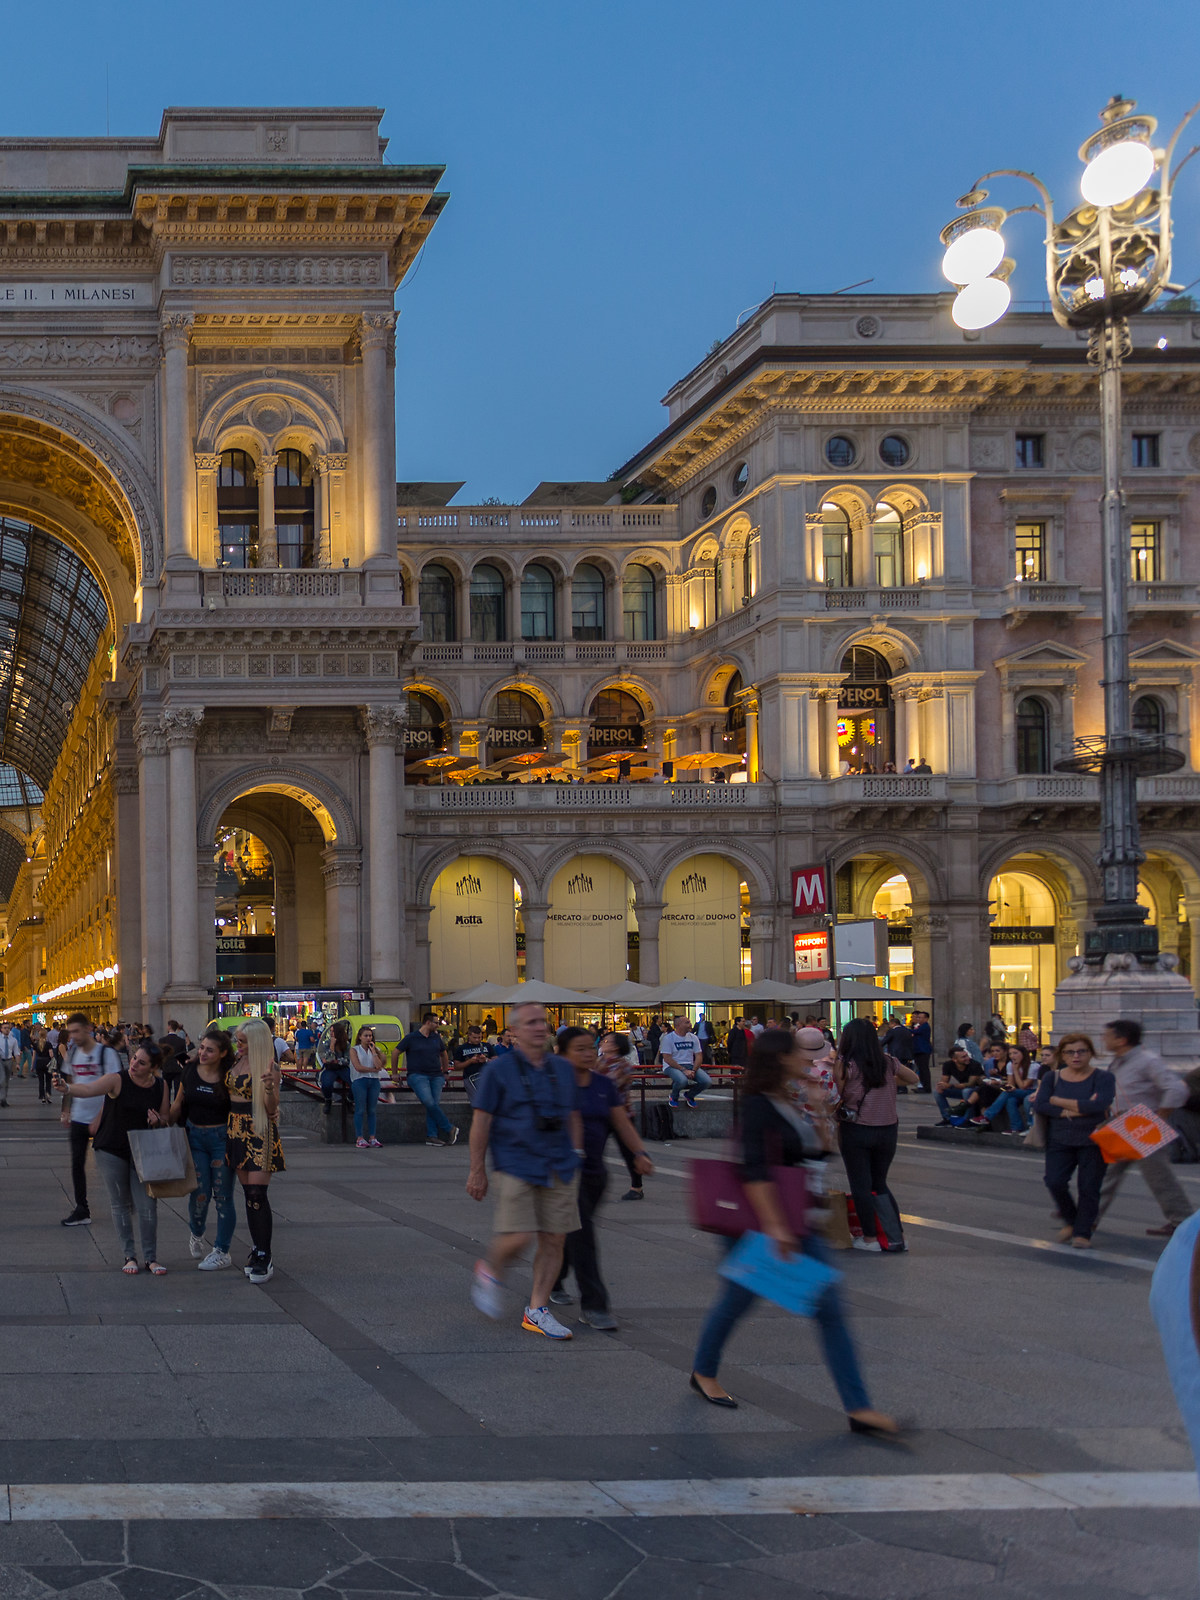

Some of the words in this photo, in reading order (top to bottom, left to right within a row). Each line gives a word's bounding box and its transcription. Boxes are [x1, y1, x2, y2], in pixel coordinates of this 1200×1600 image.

[51, 289, 55, 300] I
[64, 289, 135, 300] MILANESI
[402, 729, 435, 743] EROL
[486, 728, 534, 742] APEROL
[588, 727, 635, 741] APEROL
[795, 874, 824, 907] M
[455, 916, 482, 924] Motta
